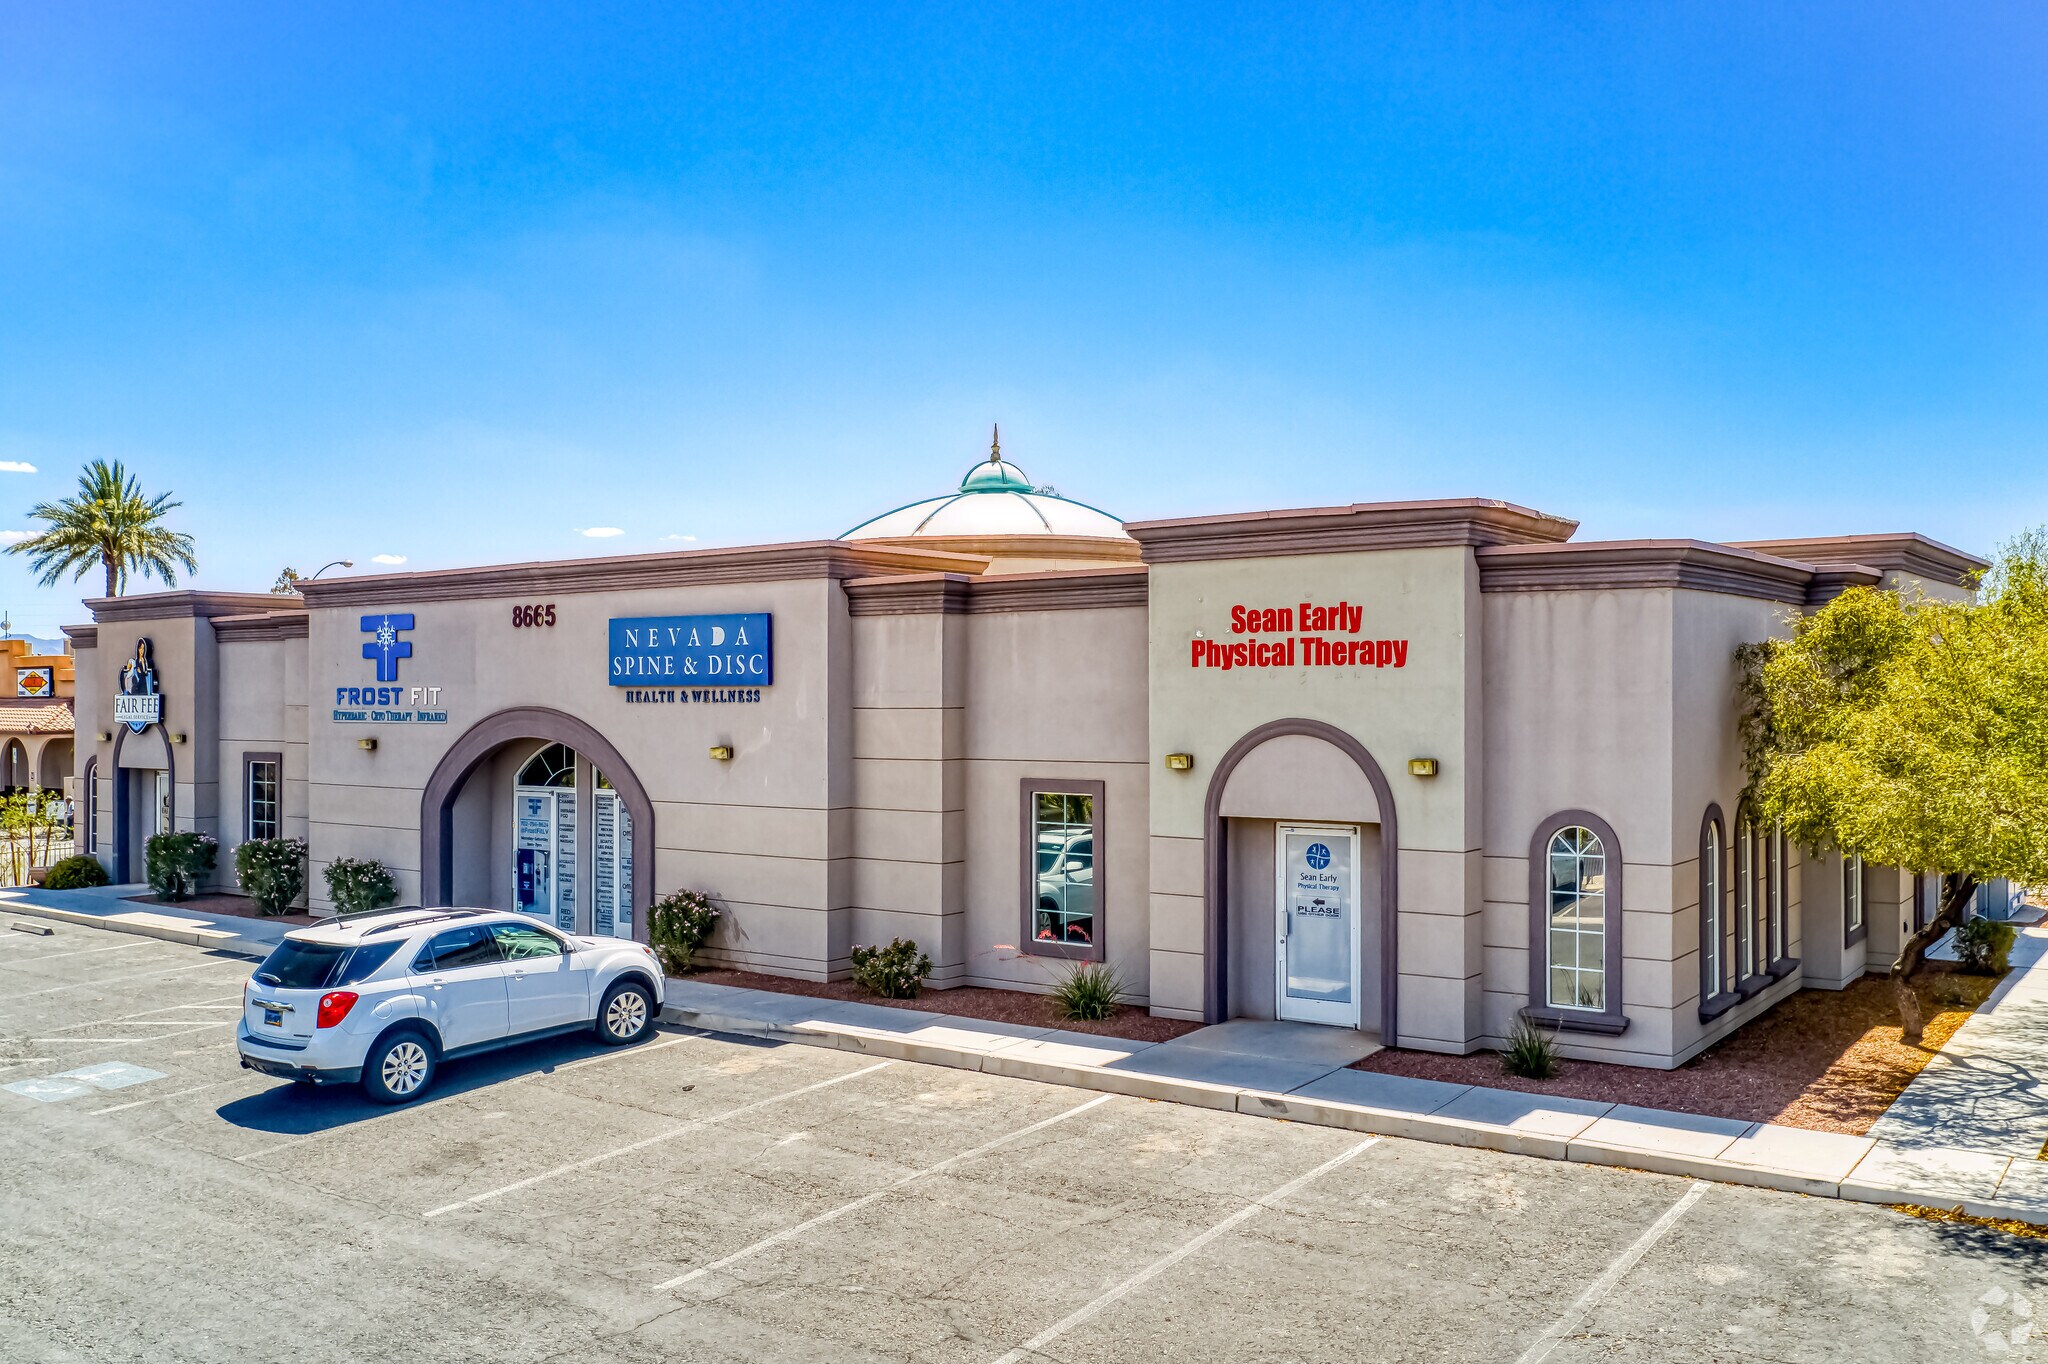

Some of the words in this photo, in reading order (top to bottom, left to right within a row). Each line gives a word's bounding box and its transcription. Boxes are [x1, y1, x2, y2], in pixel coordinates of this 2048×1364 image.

[512, 604, 556, 628] 8665
[1231, 605, 1293, 634] Sean
[1299, 602, 1363, 633] Early
[625, 626, 749, 648] NEVADA
[1191, 638, 1295, 670] Physical
[1300, 637, 1408, 668] Therapy
[613, 656, 675, 676] SPINE
[684, 657, 698, 675] &
[708, 654, 764, 675] DISC
[115, 698, 139, 713] FAIR
[141, 698, 158, 713] FEE
[336, 687, 403, 705] FROST
[411, 687, 442, 706] FIT
[625, 690, 675, 703] HEALTH
[680, 690, 689, 703] &
[691, 689, 761, 703] WELLNESS
[1300, 872, 1317, 881] Sean
[1319, 873, 1338, 883] Early
[1297, 906, 1339, 914] PLEASE
